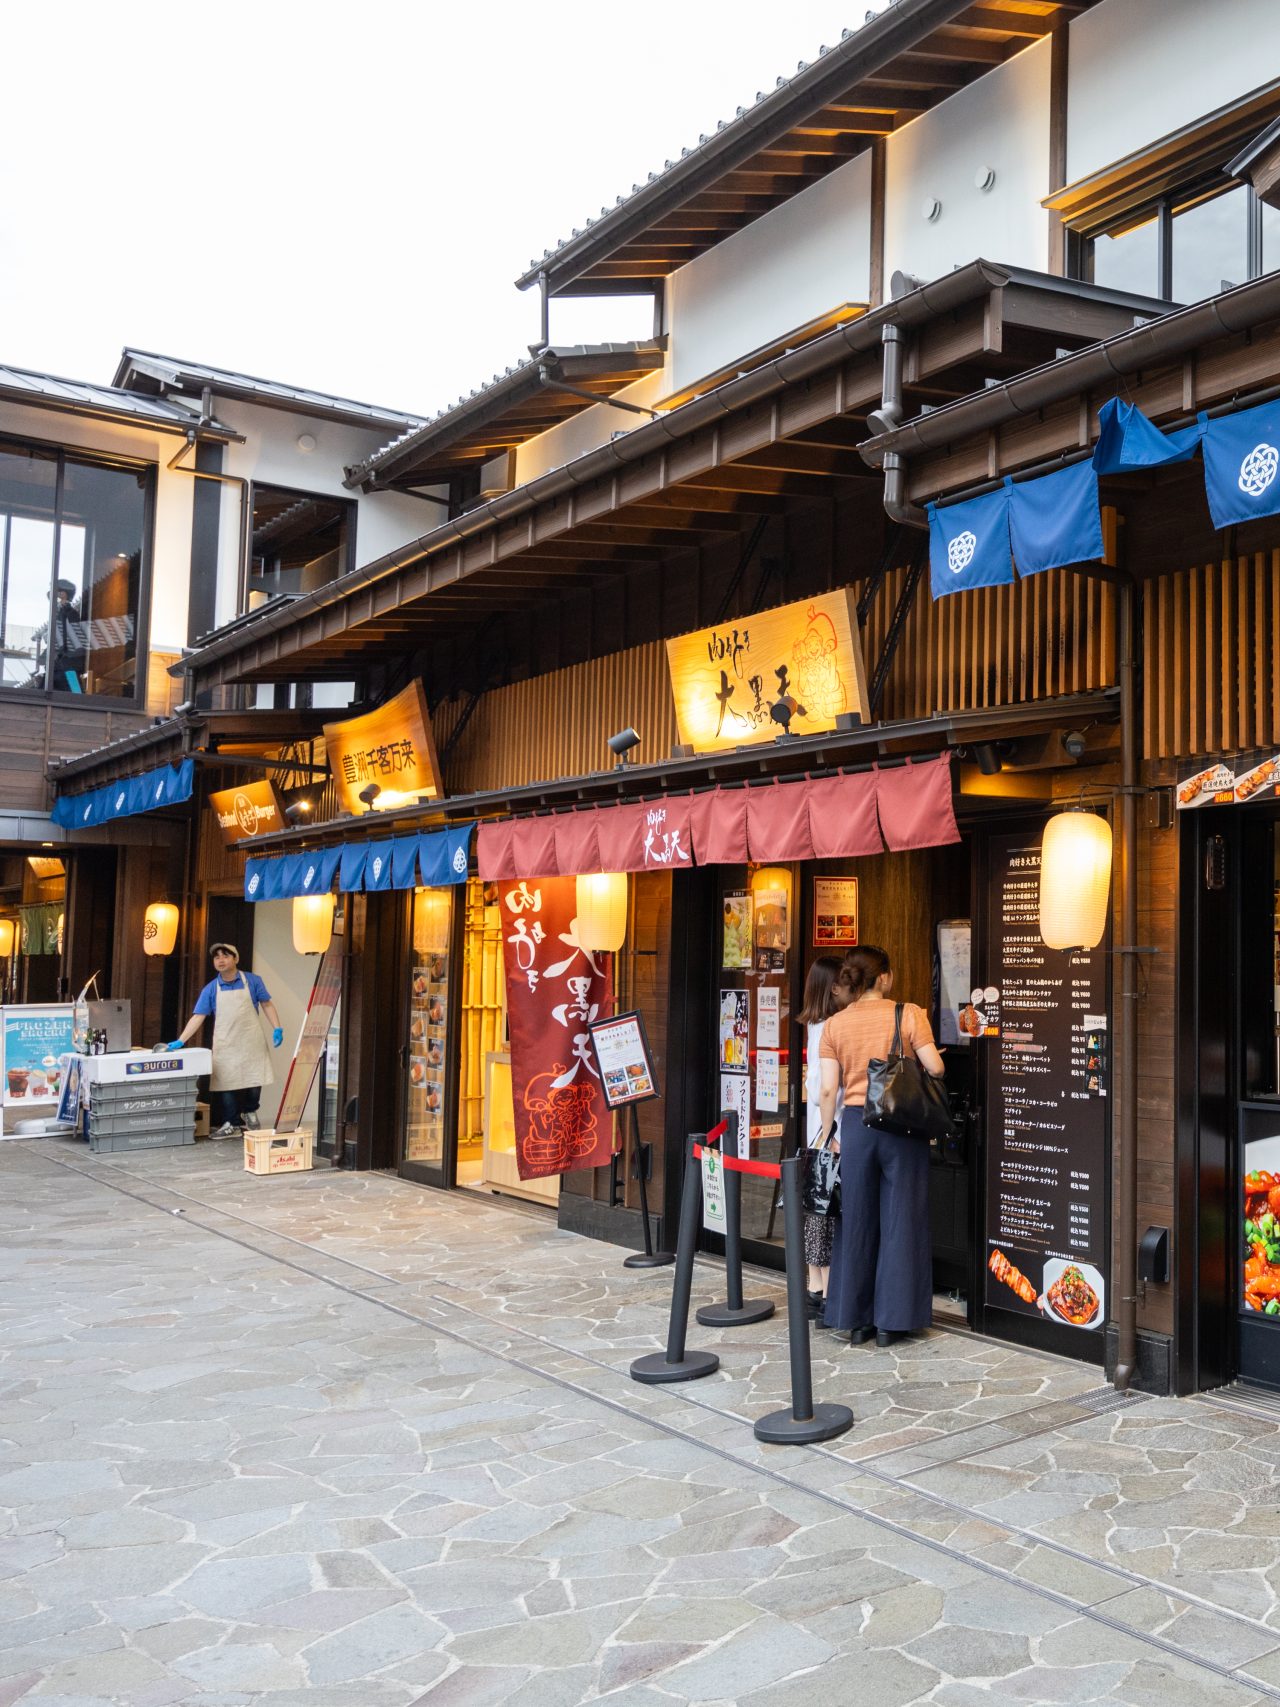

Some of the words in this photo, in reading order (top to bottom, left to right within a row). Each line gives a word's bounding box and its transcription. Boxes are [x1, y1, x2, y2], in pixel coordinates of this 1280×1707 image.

[343, 739, 416, 784] 豊洲千客万来
[143, 1060, 178, 1071] aurora
[124, 1099, 163, 1110] サンワローラン
